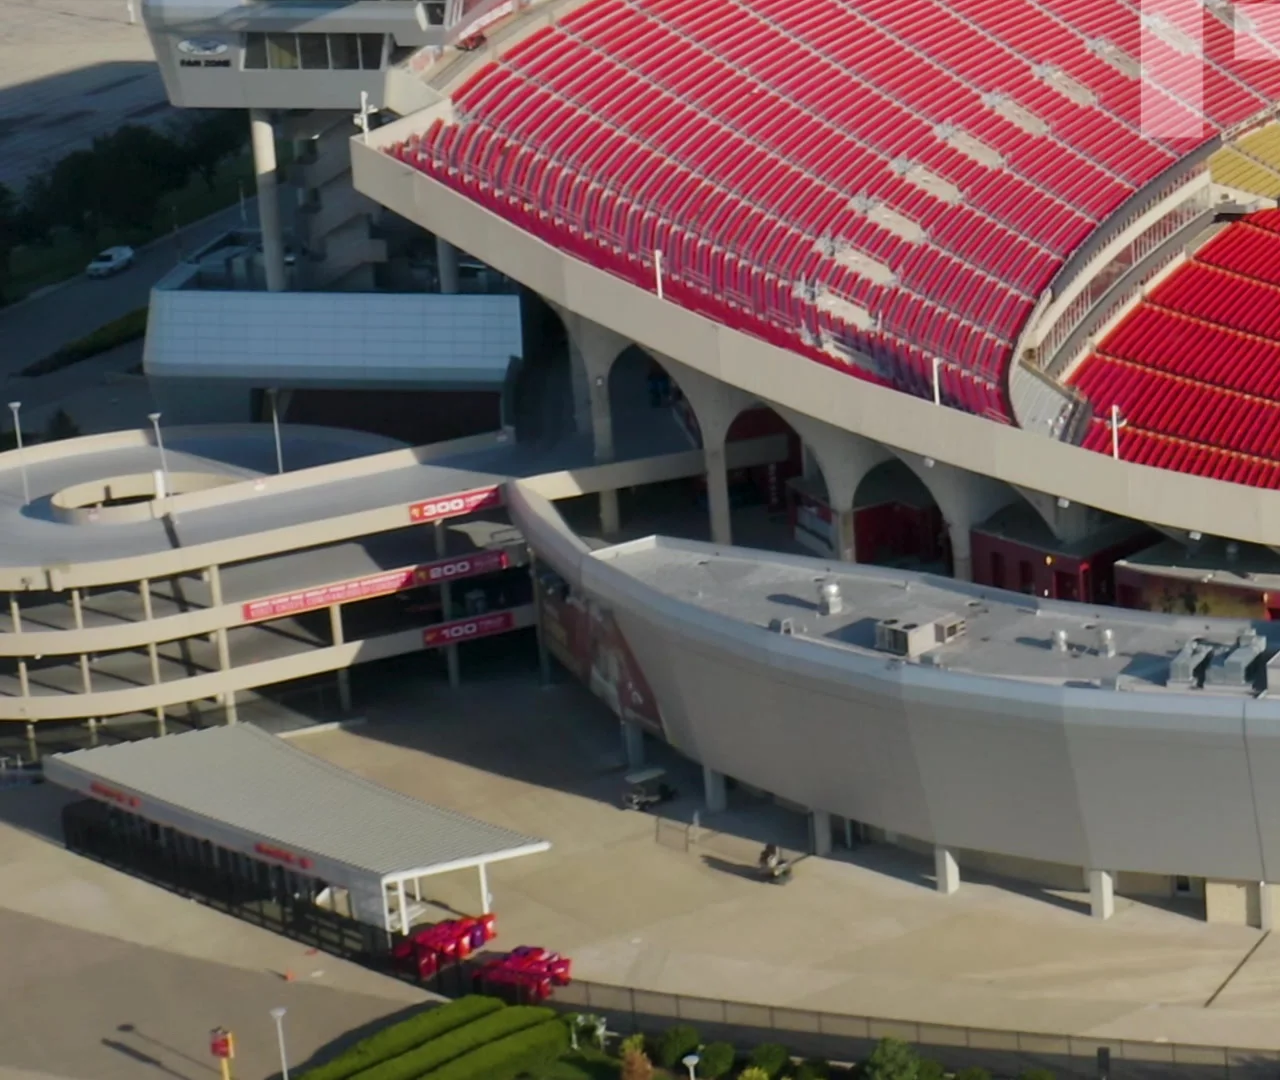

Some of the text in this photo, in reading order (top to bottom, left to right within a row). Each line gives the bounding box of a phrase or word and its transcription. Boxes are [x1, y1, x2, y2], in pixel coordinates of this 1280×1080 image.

[423, 497, 465, 517] 300
[429, 560, 471, 580] 200
[441, 622, 478, 639] 100
